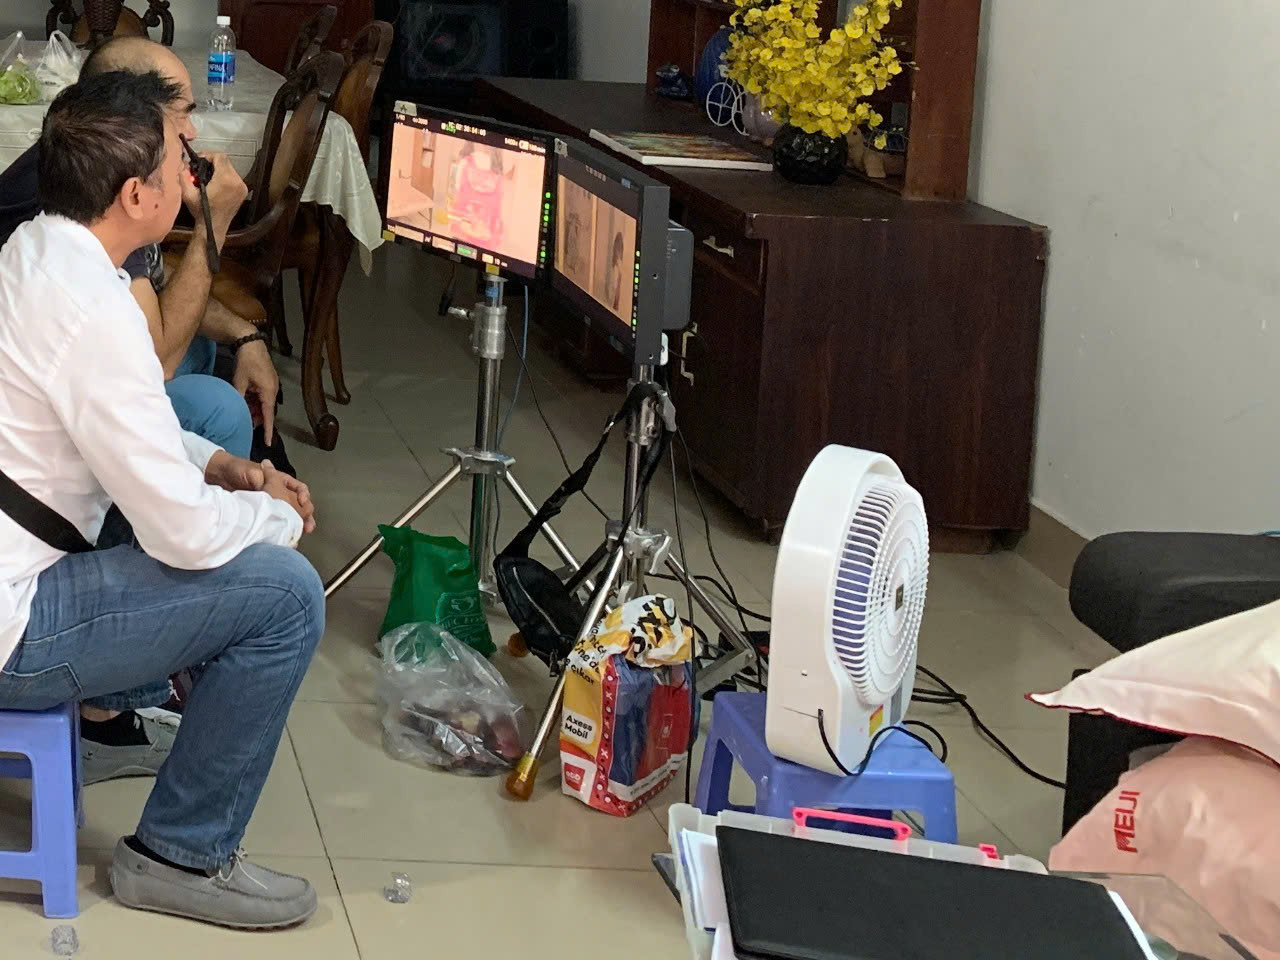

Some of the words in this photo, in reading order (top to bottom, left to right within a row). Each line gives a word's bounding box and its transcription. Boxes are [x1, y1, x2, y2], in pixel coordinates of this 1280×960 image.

[565, 722, 589, 740] Mobil
[566, 714, 593, 732] Axess
[1114, 790, 1140, 853] MEIJI
